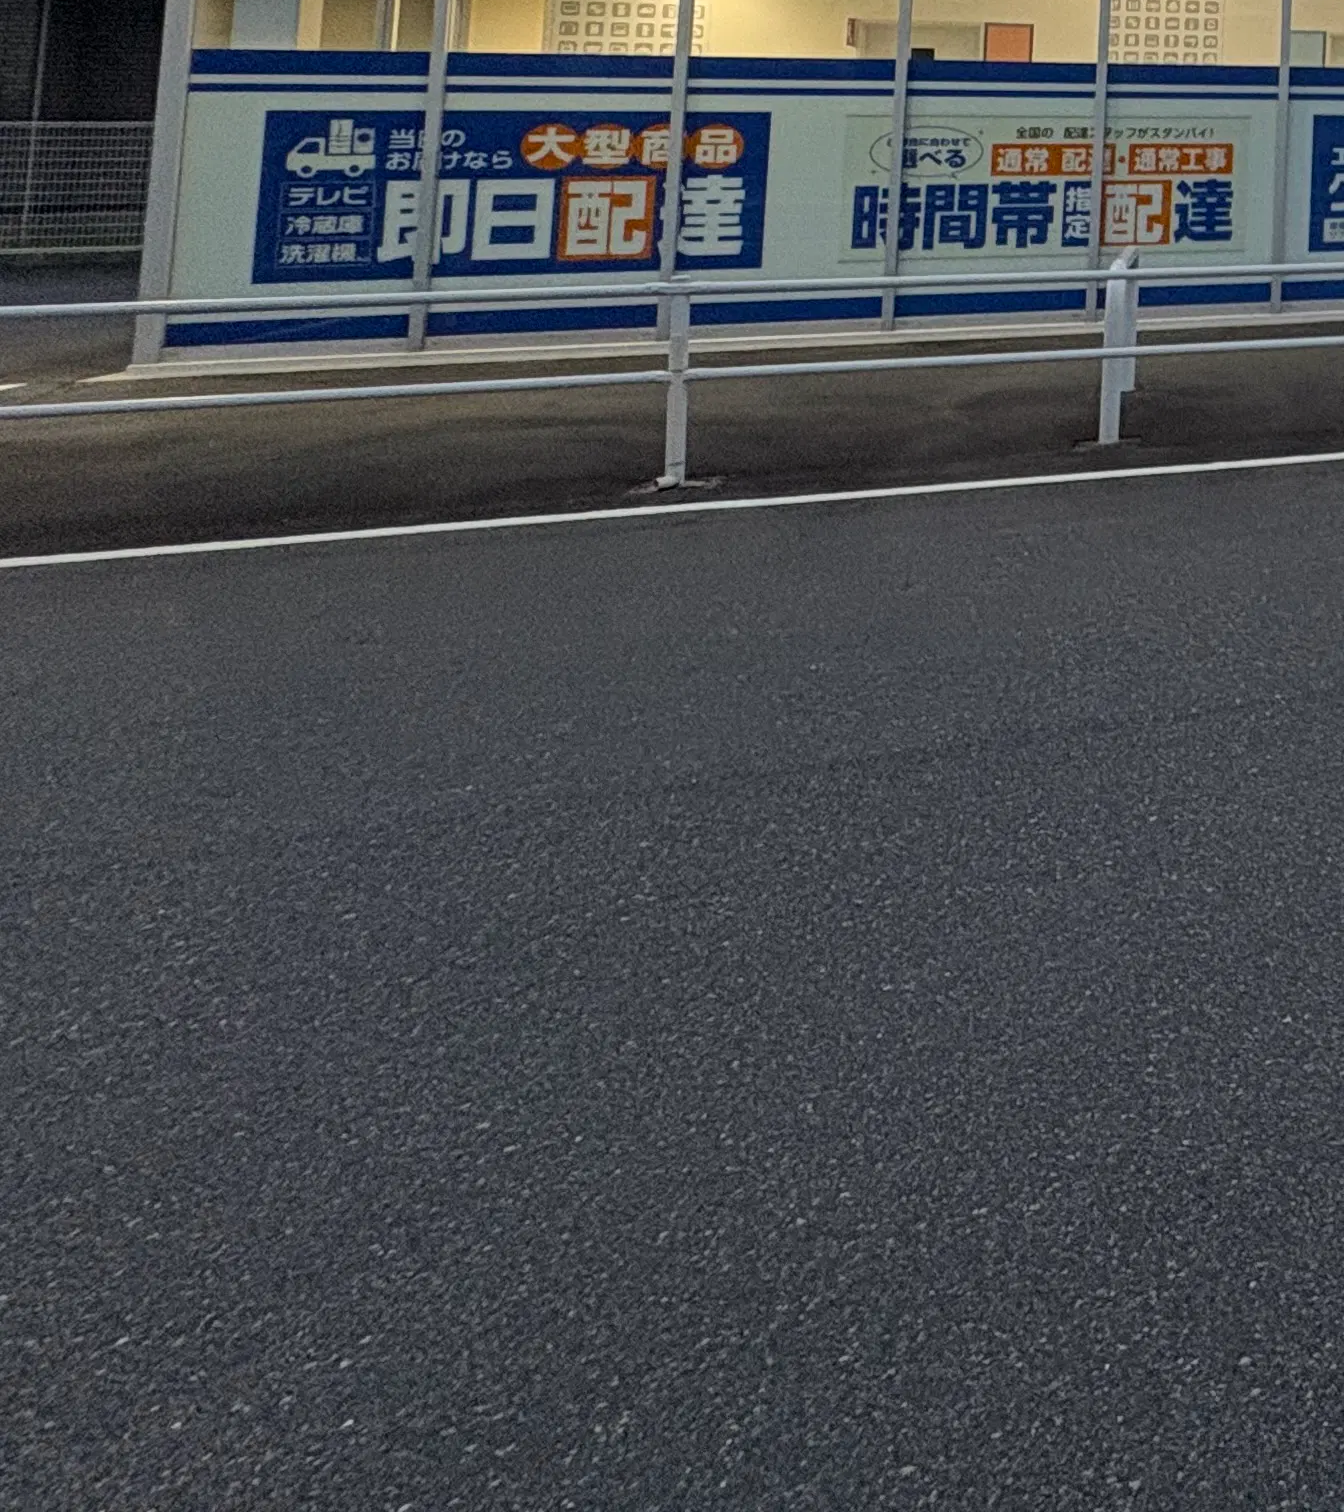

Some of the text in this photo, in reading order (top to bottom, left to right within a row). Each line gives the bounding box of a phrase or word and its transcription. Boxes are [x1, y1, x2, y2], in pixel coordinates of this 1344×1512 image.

[526, 125, 739, 166] 大型商品
[287, 185, 371, 207] テレビ
[376, 174, 746, 266] 即日配達
